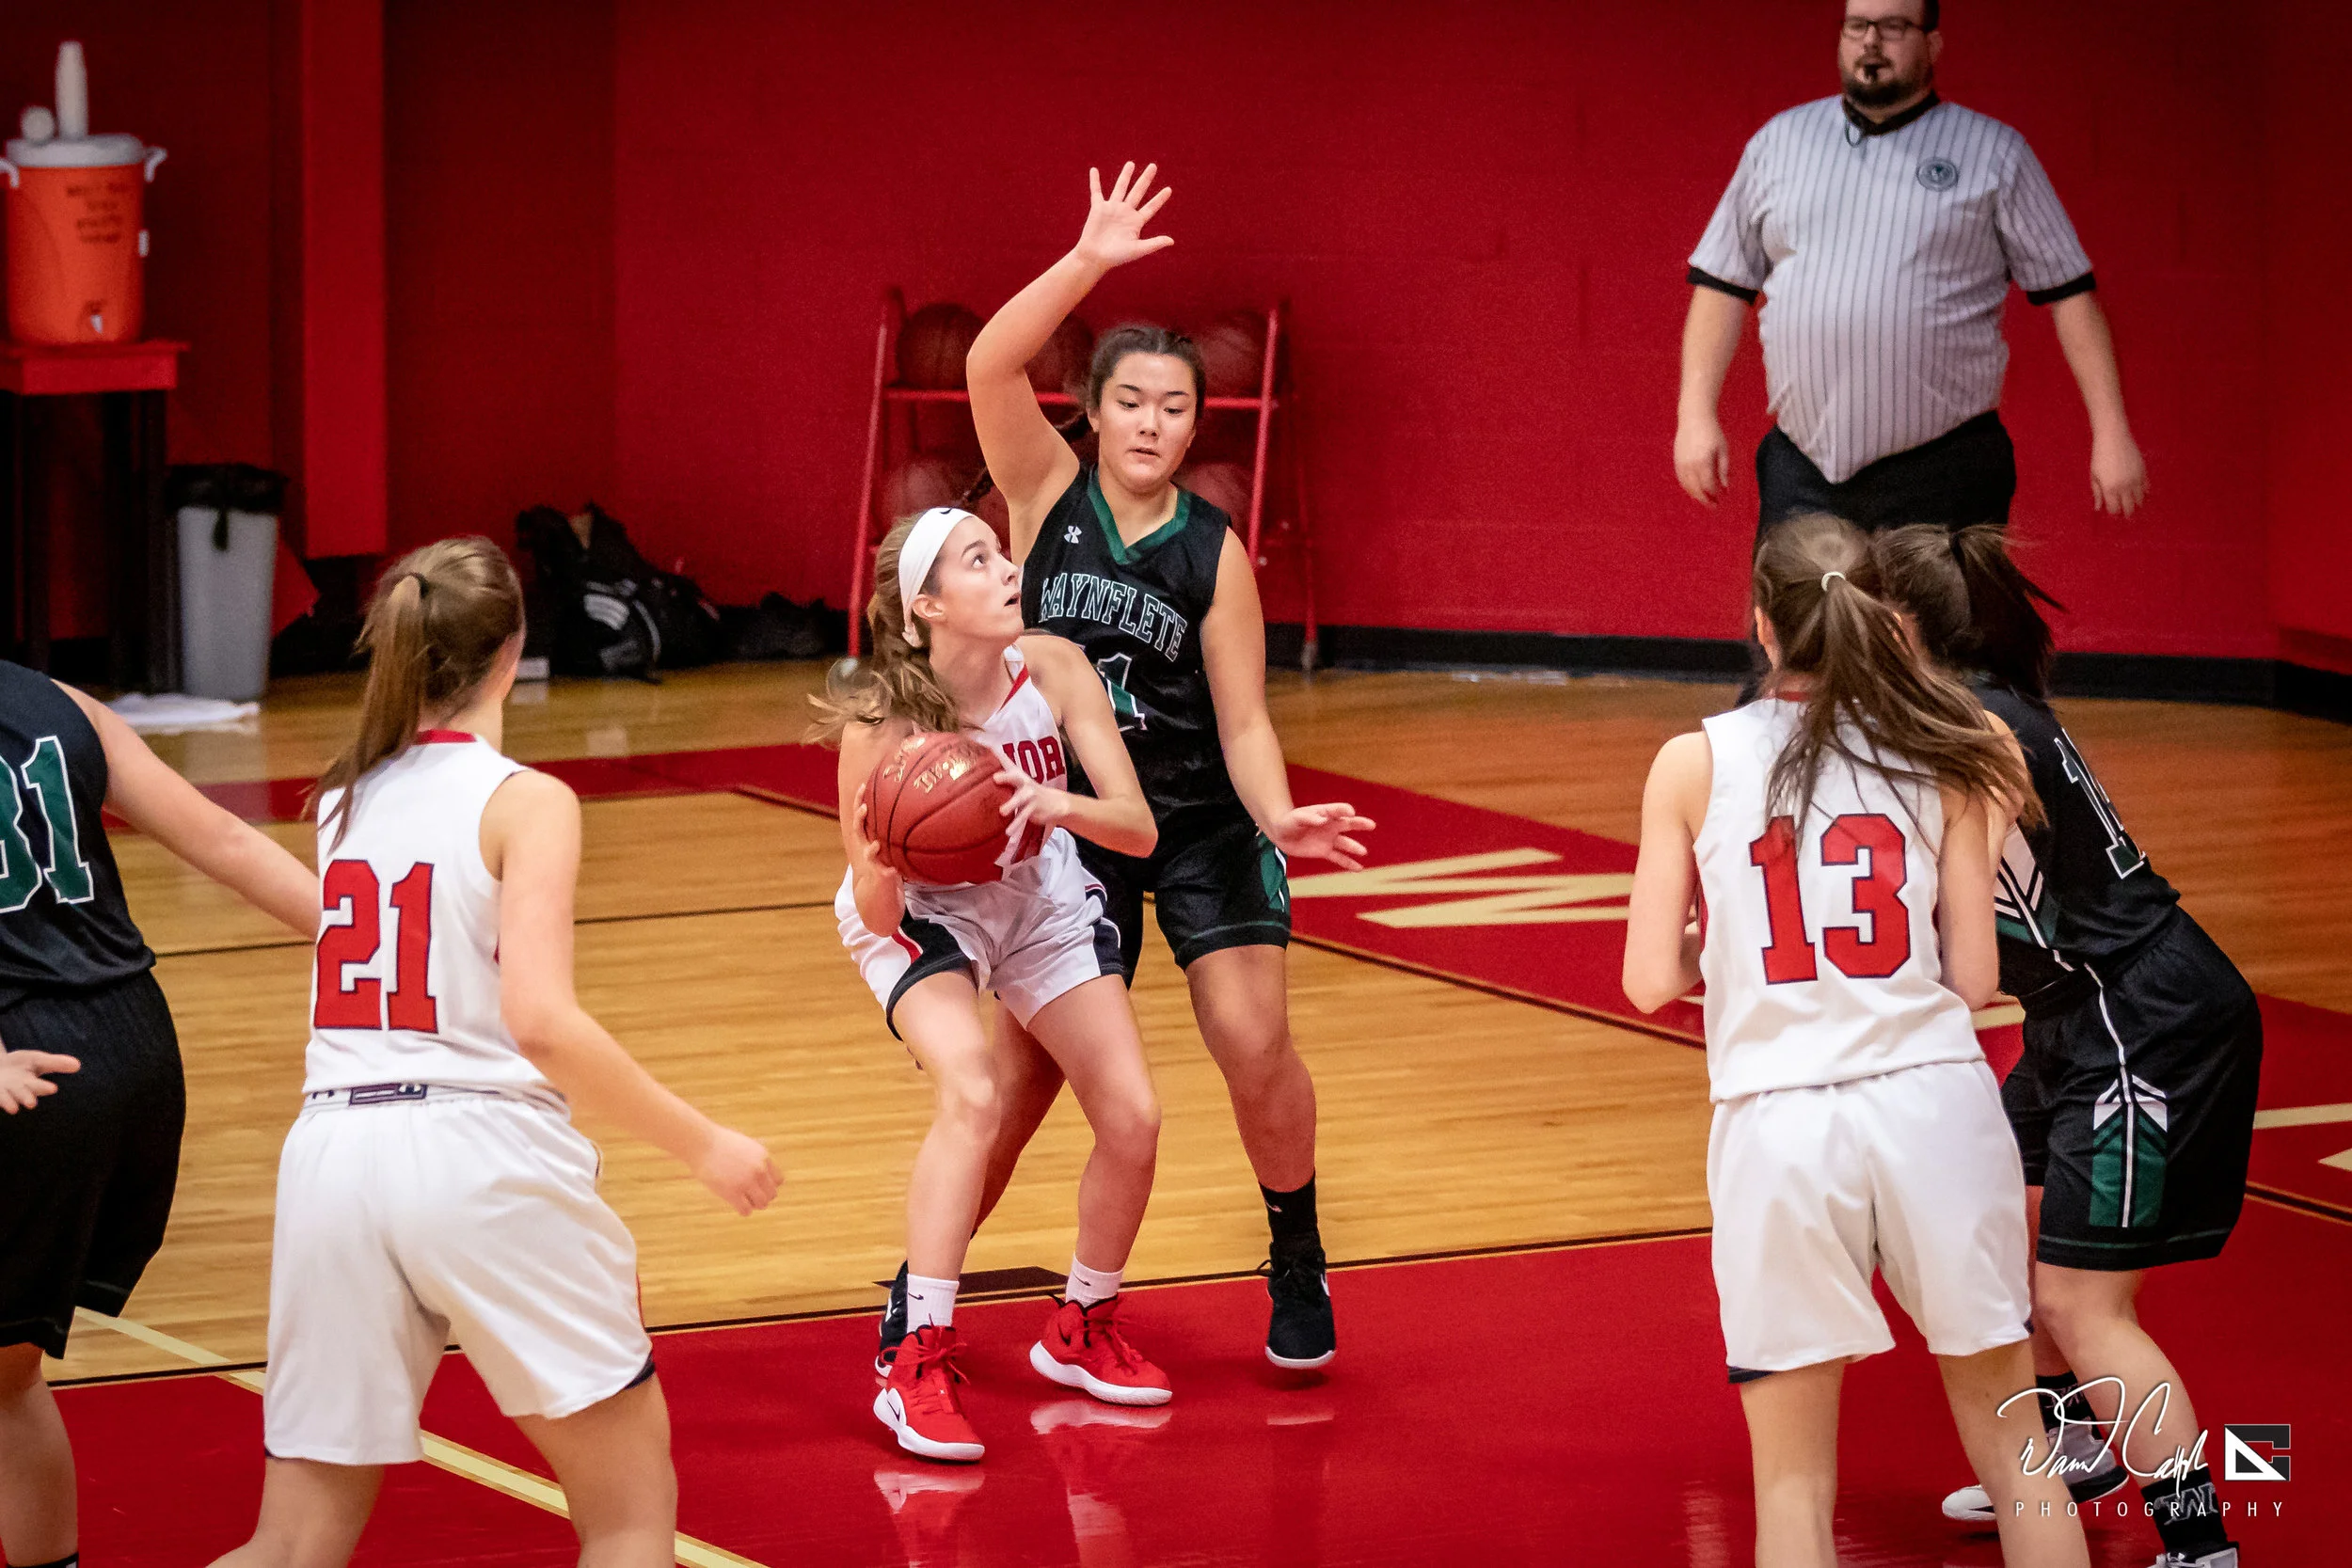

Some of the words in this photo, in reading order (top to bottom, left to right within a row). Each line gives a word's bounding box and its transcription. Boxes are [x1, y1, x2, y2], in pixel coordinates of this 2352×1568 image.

[1039, 573, 1187, 661] WAYNFLETE
[2054, 721, 2145, 879] 1
[314, 859, 438, 1034] 21
[1749, 814, 1912, 985] 13
